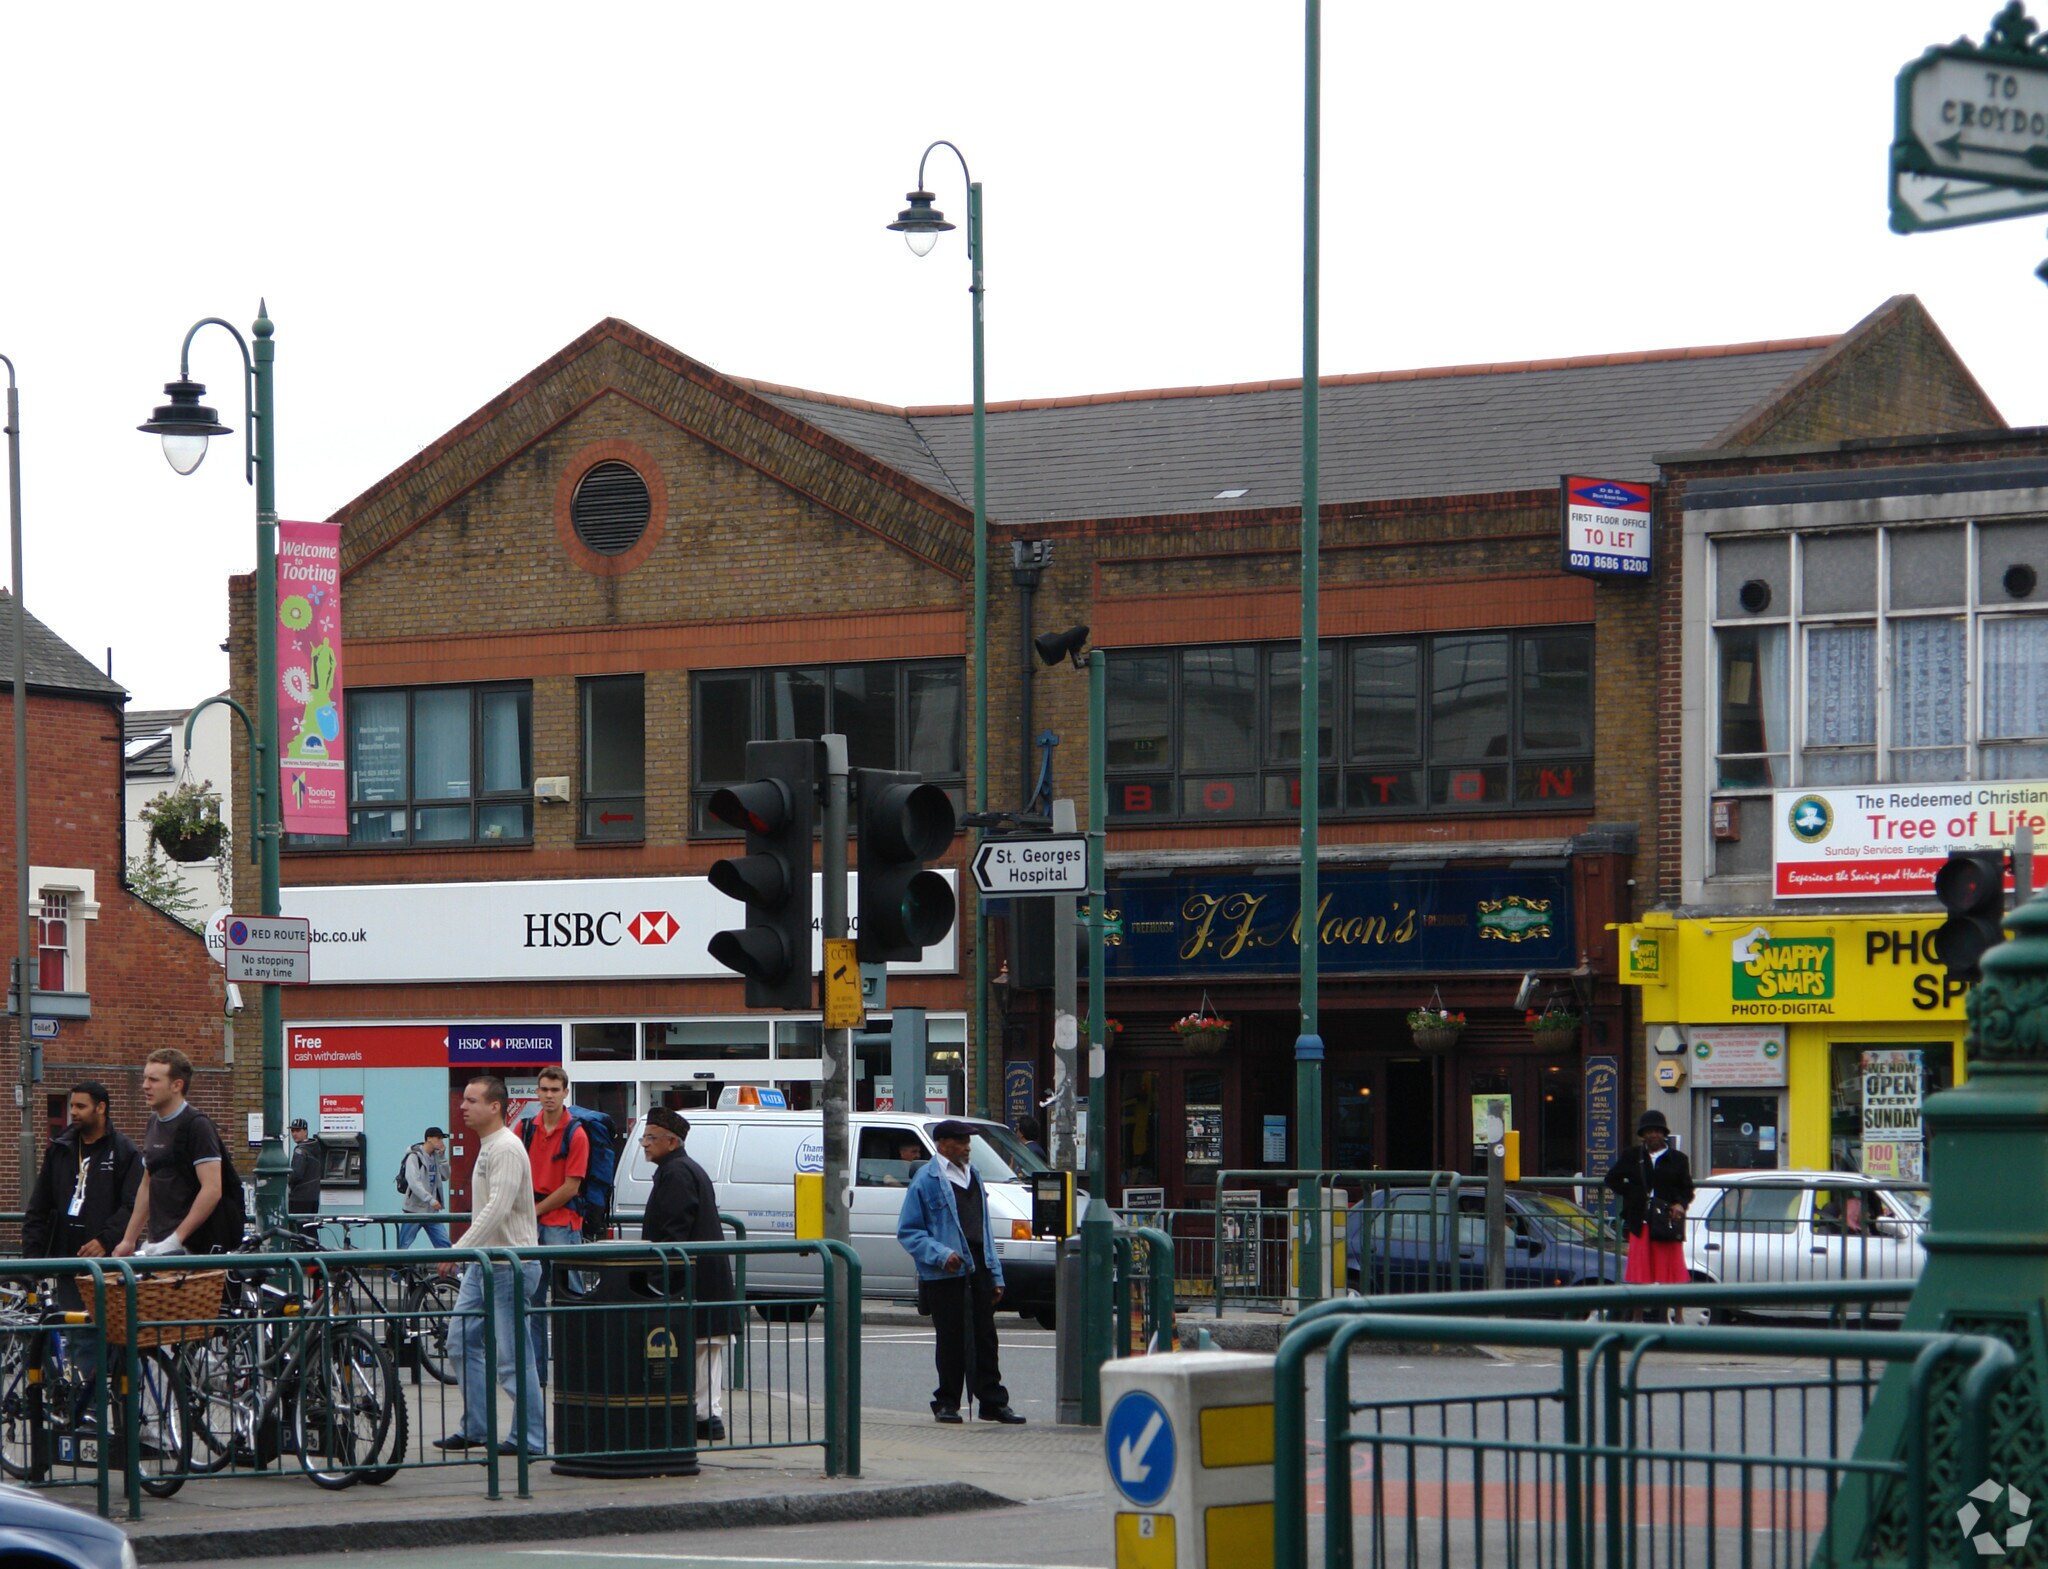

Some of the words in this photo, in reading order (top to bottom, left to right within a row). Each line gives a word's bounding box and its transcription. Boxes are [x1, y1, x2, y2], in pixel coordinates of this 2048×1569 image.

[1986, 72, 2018, 99] TO
[1941, 100, 2048, 137] CROYDO
[1571, 512, 1592, 522] FIRST
[1596, 515, 1620, 525] FLOOR
[1622, 518, 1647, 529] OFFICE
[1585, 528, 1604, 545] TO
[1610, 531, 1634, 548] LET
[282, 541, 337, 559] Welcome
[294, 557, 303, 565] to
[1570, 553, 1590, 567] 020
[1594, 555, 1619, 570] 8686
[1623, 559, 1648, 572] 8208
[282, 563, 337, 585] Tooting
[307, 786, 336, 799] Tooting
[1856, 795, 1885, 809] The
[1890, 791, 1973, 808] Redeemed
[1977, 788, 2048, 805] Christian
[1866, 814, 1937, 840] Tree
[1947, 811, 1979, 837] of
[1989, 810, 2046, 836] Life
[996, 849, 1016, 864] St.
[1022, 848, 1081, 865] Georges
[1824, 846, 1861, 858] Sunday
[1863, 845, 1904, 855] Services
[1907, 844, 1941, 855] English:
[1009, 866, 1068, 884] Hospital
[1788, 870, 1834, 884] Experience
[1835, 870, 1849, 882] the
[1850, 868, 1880, 883] Saving
[1881, 869, 1900, 882] and
[1902, 867, 1937, 881] Healing
[251, 928, 271, 939] RED
[274, 929, 306, 941] ROUTE
[523, 911, 623, 947] HSBC
[208, 934, 225, 949] HS
[241, 954, 255, 965] No
[257, 955, 294, 967] stopping
[831, 949, 856, 961] CCTV
[1744, 937, 1829, 978] SNAPPY
[244, 967, 253, 976] at
[256, 969, 270, 978] any
[273, 967, 293, 978] time
[1756, 970, 1827, 999] SNAPS
[1912, 972, 1981, 1011] SP
[34, 1023, 51, 1032] Toilet
[294, 1035, 322, 1049] Free
[458, 1038, 486, 1050] HSBC
[505, 1037, 553, 1050] PREMIER
[294, 1051, 313, 1062] cash
[314, 1050, 362, 1062] withdrawals
[1867, 1063, 1885, 1074] WE
[1888, 1062, 1917, 1073] NOW
[510, 1087, 525, 1095] Bank
[526, 1087, 537, 1095] Acc
[881, 1086, 894, 1095] Ban
[928, 1086, 943, 1094] Plus
[1866, 1075, 1918, 1096] OPEN
[323, 1098, 338, 1106] Free
[760, 1092, 784, 1105] WATER
[1868, 1097, 1917, 1106] EVERY
[1864, 1108, 1921, 1129] SUNDAY
[802, 1143, 824, 1153] Tham
[1867, 1144, 1893, 1161] 100
[804, 1153, 824, 1162] Wate
[1868, 1162, 1891, 1171] Prints
[1143, 1519, 1151, 1535] 2
